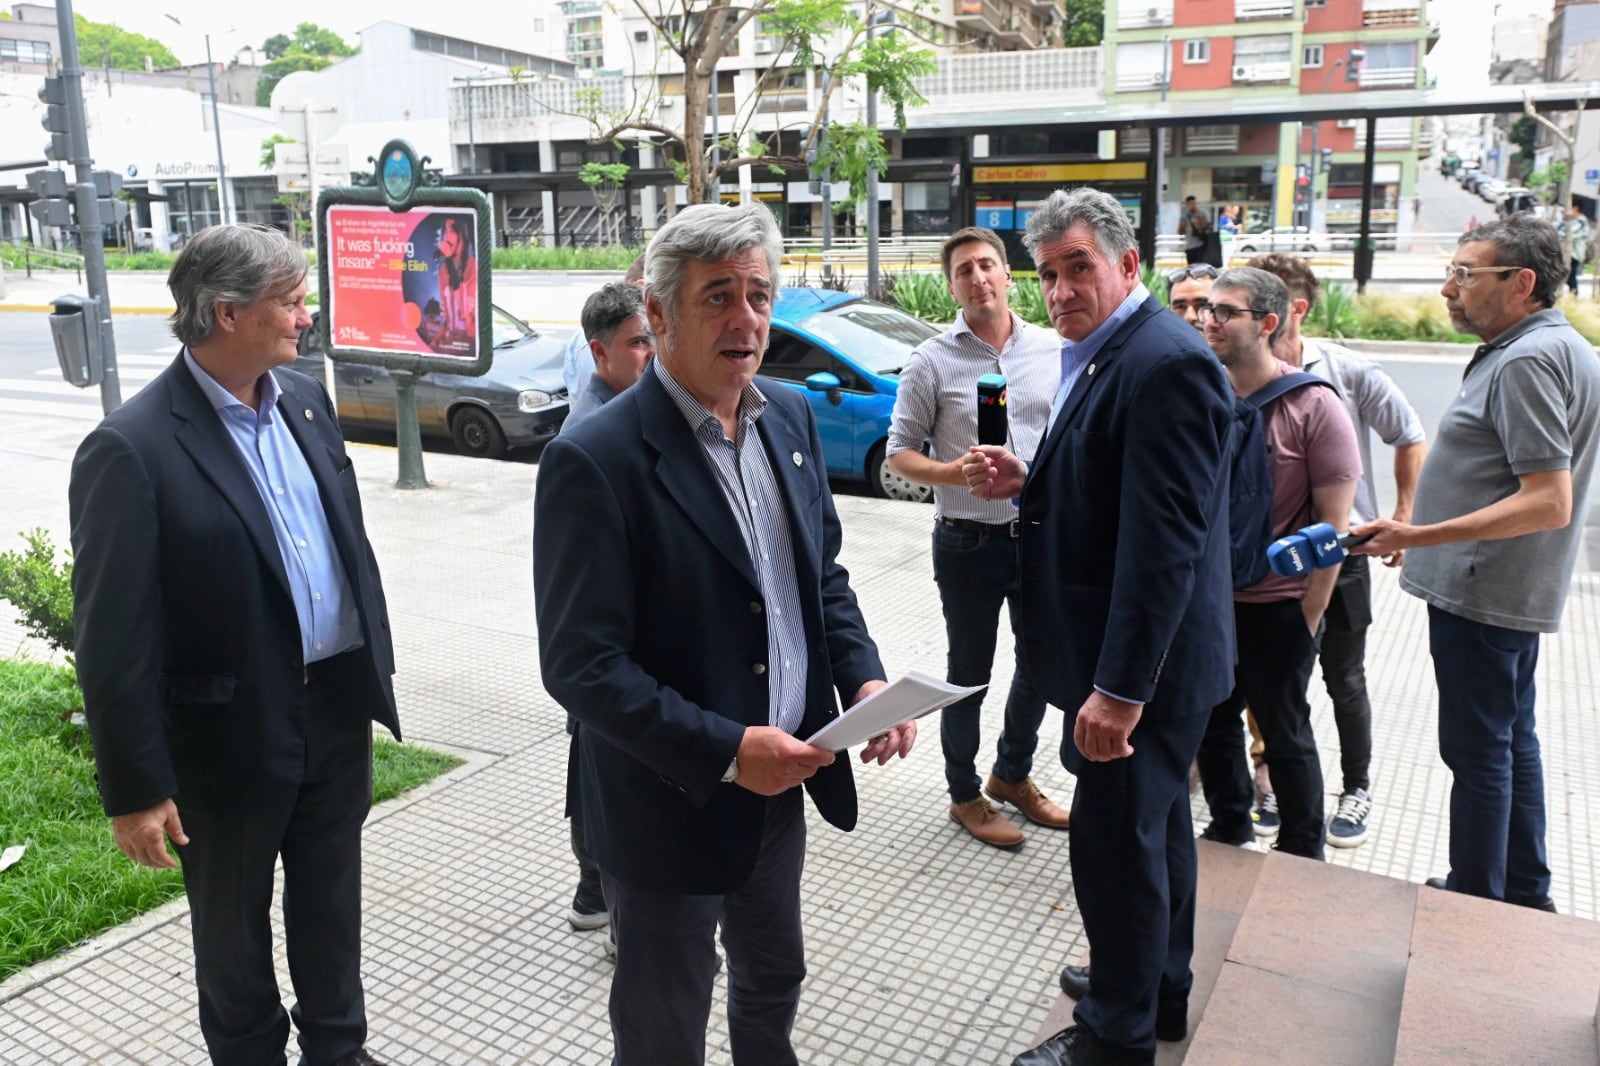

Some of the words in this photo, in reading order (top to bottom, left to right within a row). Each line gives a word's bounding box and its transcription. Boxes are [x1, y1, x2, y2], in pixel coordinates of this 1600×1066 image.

[977, 169, 1012, 180] Carlos
[1015, 168, 1047, 179] Calvo
[989, 211, 1000, 227] 8
[336, 236, 345, 251] It
[347, 239, 372, 252] was
[373, 236, 415, 258] fucking
